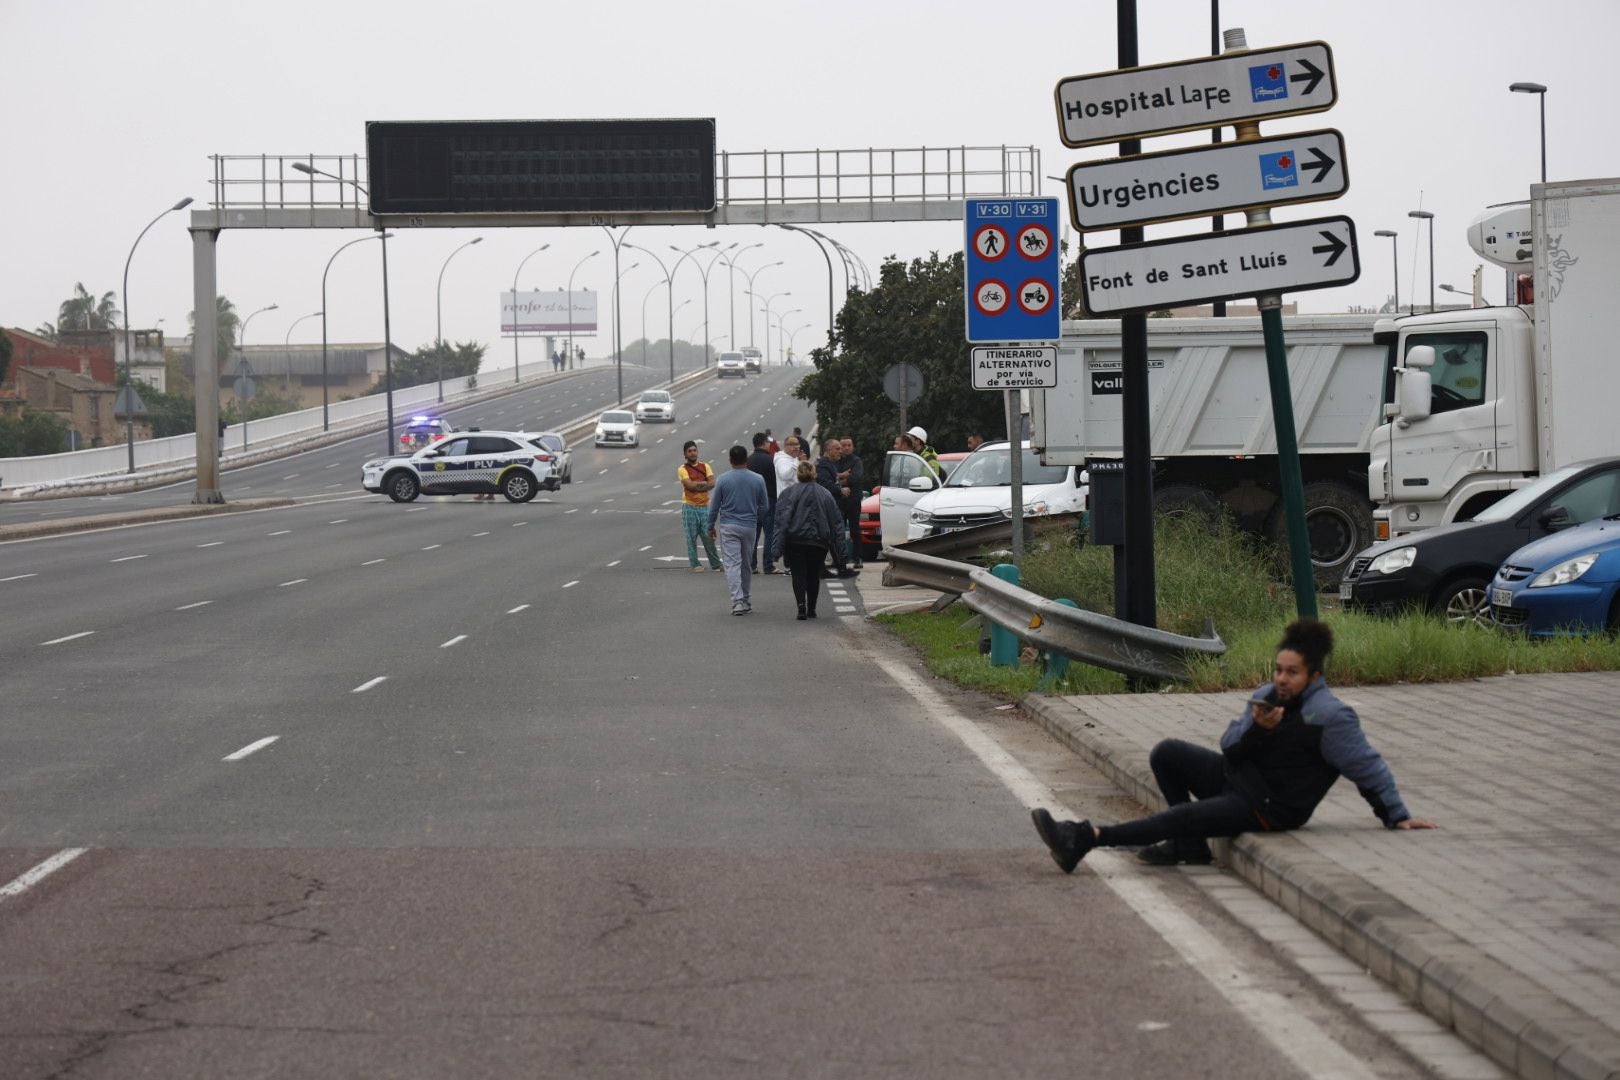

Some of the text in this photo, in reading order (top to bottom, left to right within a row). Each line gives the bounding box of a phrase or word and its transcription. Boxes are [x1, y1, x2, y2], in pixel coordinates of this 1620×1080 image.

[1065, 87, 1175, 121] Hospital
[1079, 172, 1221, 208] Urgències
[980, 203, 1046, 216] V-30 V-31
[1088, 252, 1288, 292] Font de Sant Lluís
[986, 350, 1043, 359] ITINERARIO
[979, 360, 1051, 368] ALTERNATIVO
[997, 371, 1013, 379] por
[987, 378, 1043, 387] de servicio
[1094, 378, 1123, 388] vall
